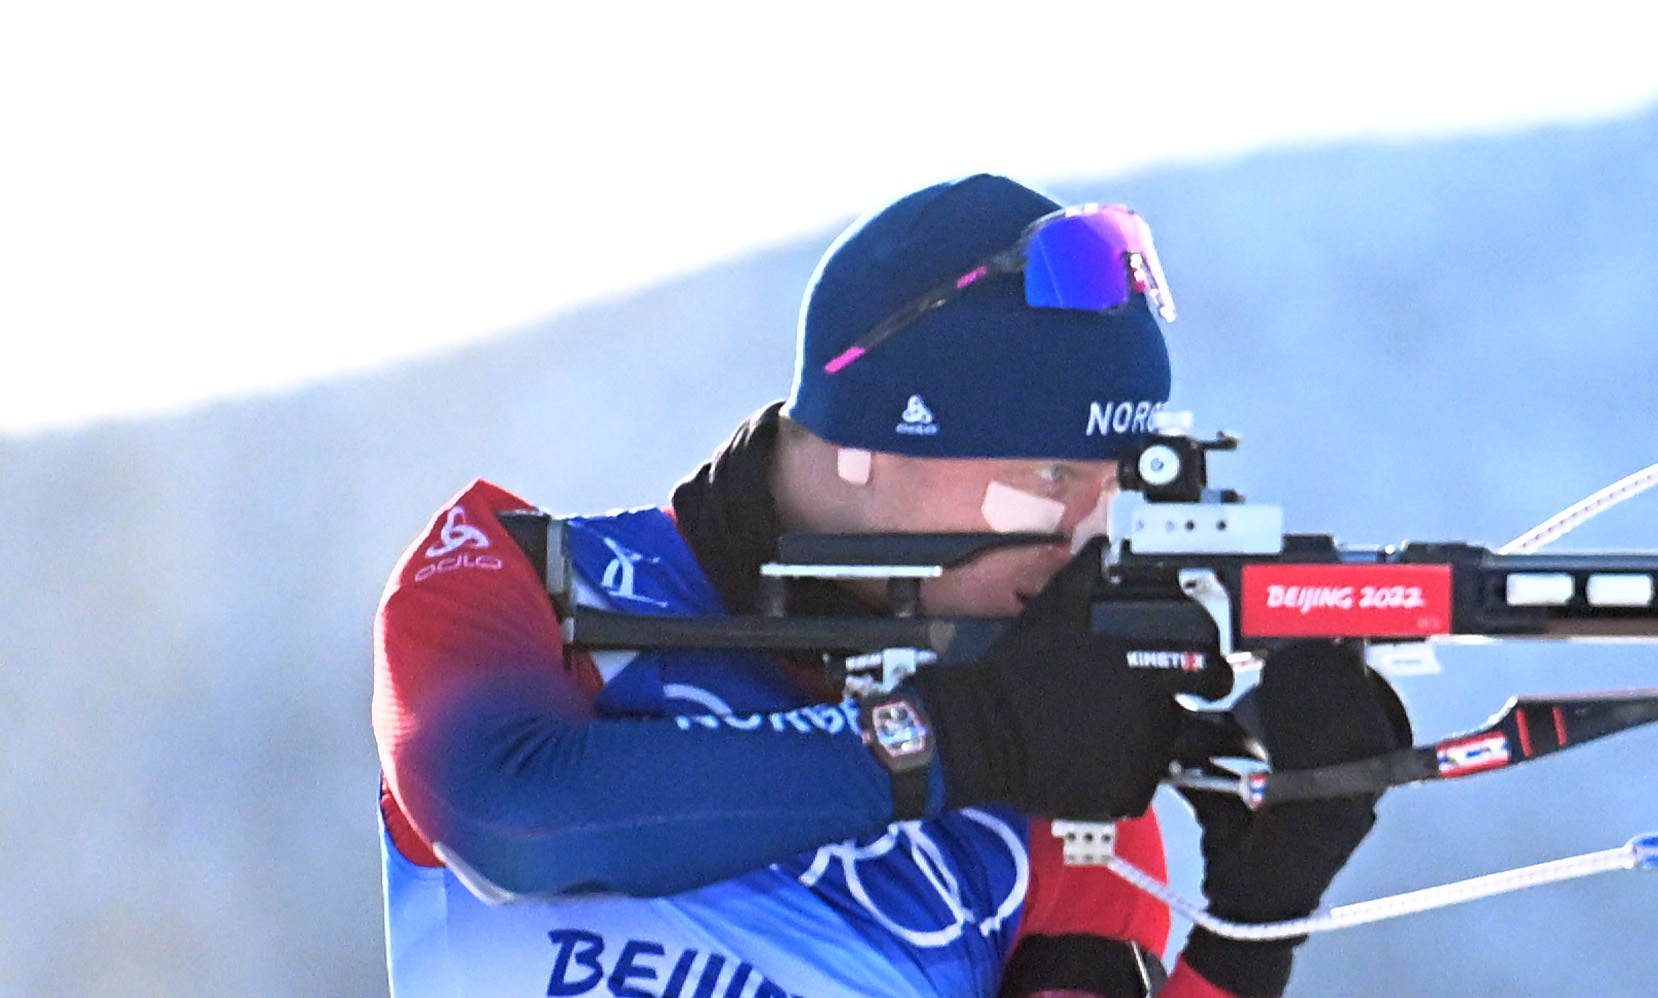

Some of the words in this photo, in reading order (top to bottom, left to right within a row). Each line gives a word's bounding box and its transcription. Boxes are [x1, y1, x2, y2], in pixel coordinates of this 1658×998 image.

[414, 554, 503, 582] odlo
[1267, 585, 1354, 614] BEIJING
[1359, 586, 1425, 609] 2022
